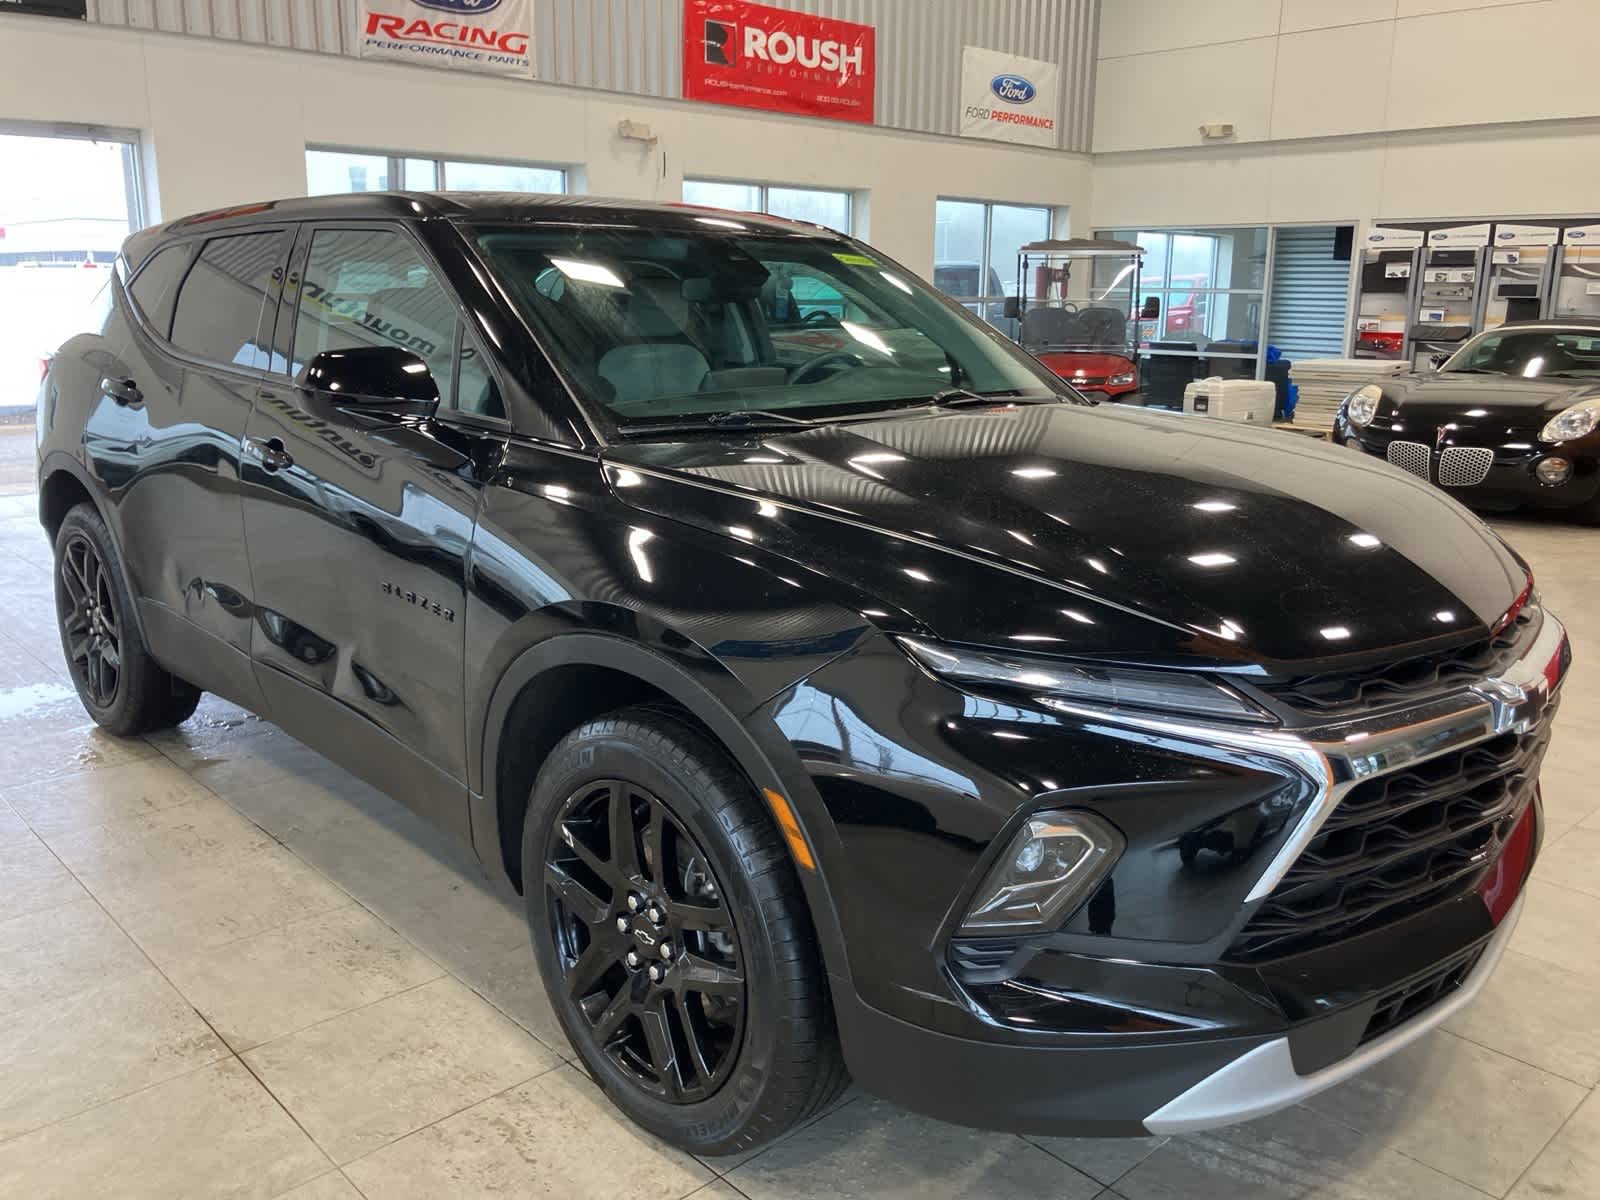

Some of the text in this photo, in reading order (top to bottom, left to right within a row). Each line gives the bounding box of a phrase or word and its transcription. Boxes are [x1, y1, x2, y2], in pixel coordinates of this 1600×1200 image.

[366, 12, 530, 55] RACING
[366, 38, 530, 67] PERFORMANCE PARTS
[743, 26, 863, 76] ROUSH
[999, 78, 1028, 100] Ford
[965, 106, 1054, 129] FORD PERFORMANCE
